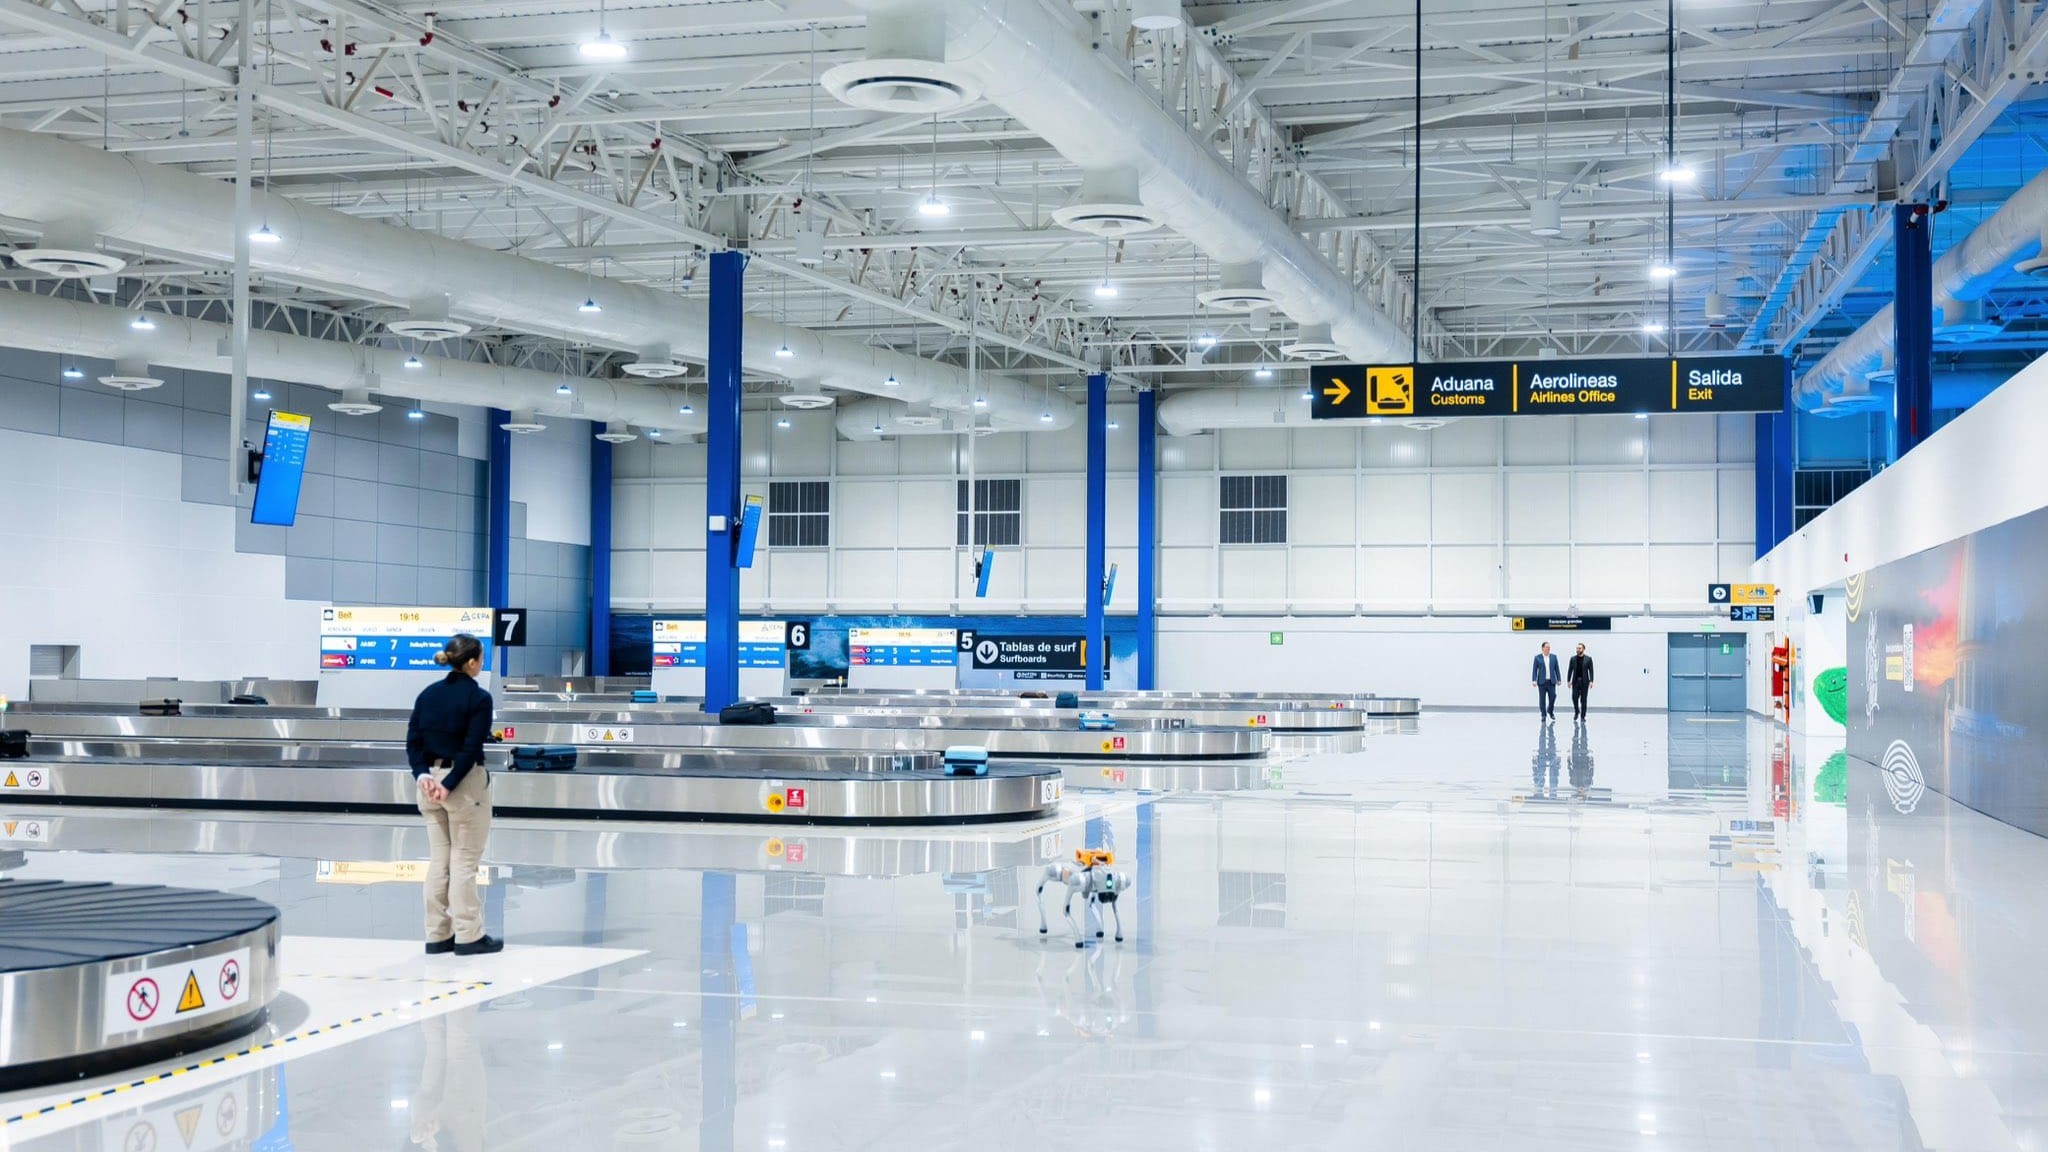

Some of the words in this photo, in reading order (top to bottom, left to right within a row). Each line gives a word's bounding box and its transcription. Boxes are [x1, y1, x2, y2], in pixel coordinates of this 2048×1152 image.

[1431, 376, 1494, 392] Aduana
[1530, 373, 1617, 389] Aerolineas
[1689, 369, 1742, 386] Salida
[1431, 393, 1486, 406] Customs
[1530, 391, 1575, 403] Airlines
[1578, 390, 1615, 402] Office
[1689, 388, 1712, 400] Exit
[338, 611, 352, 619] Belt
[400, 613, 419, 621] 19:16
[500, 613, 520, 642] 7
[791, 624, 806, 647] 6
[961, 632, 973, 649] 5
[390, 639, 397, 650] 7
[1000, 642, 1034, 652] Tablas
[1038, 642, 1051, 652] de
[1054, 642, 1077, 652] surf
[390, 657, 397, 668] 7
[1000, 655, 1047, 663] Surfboards
